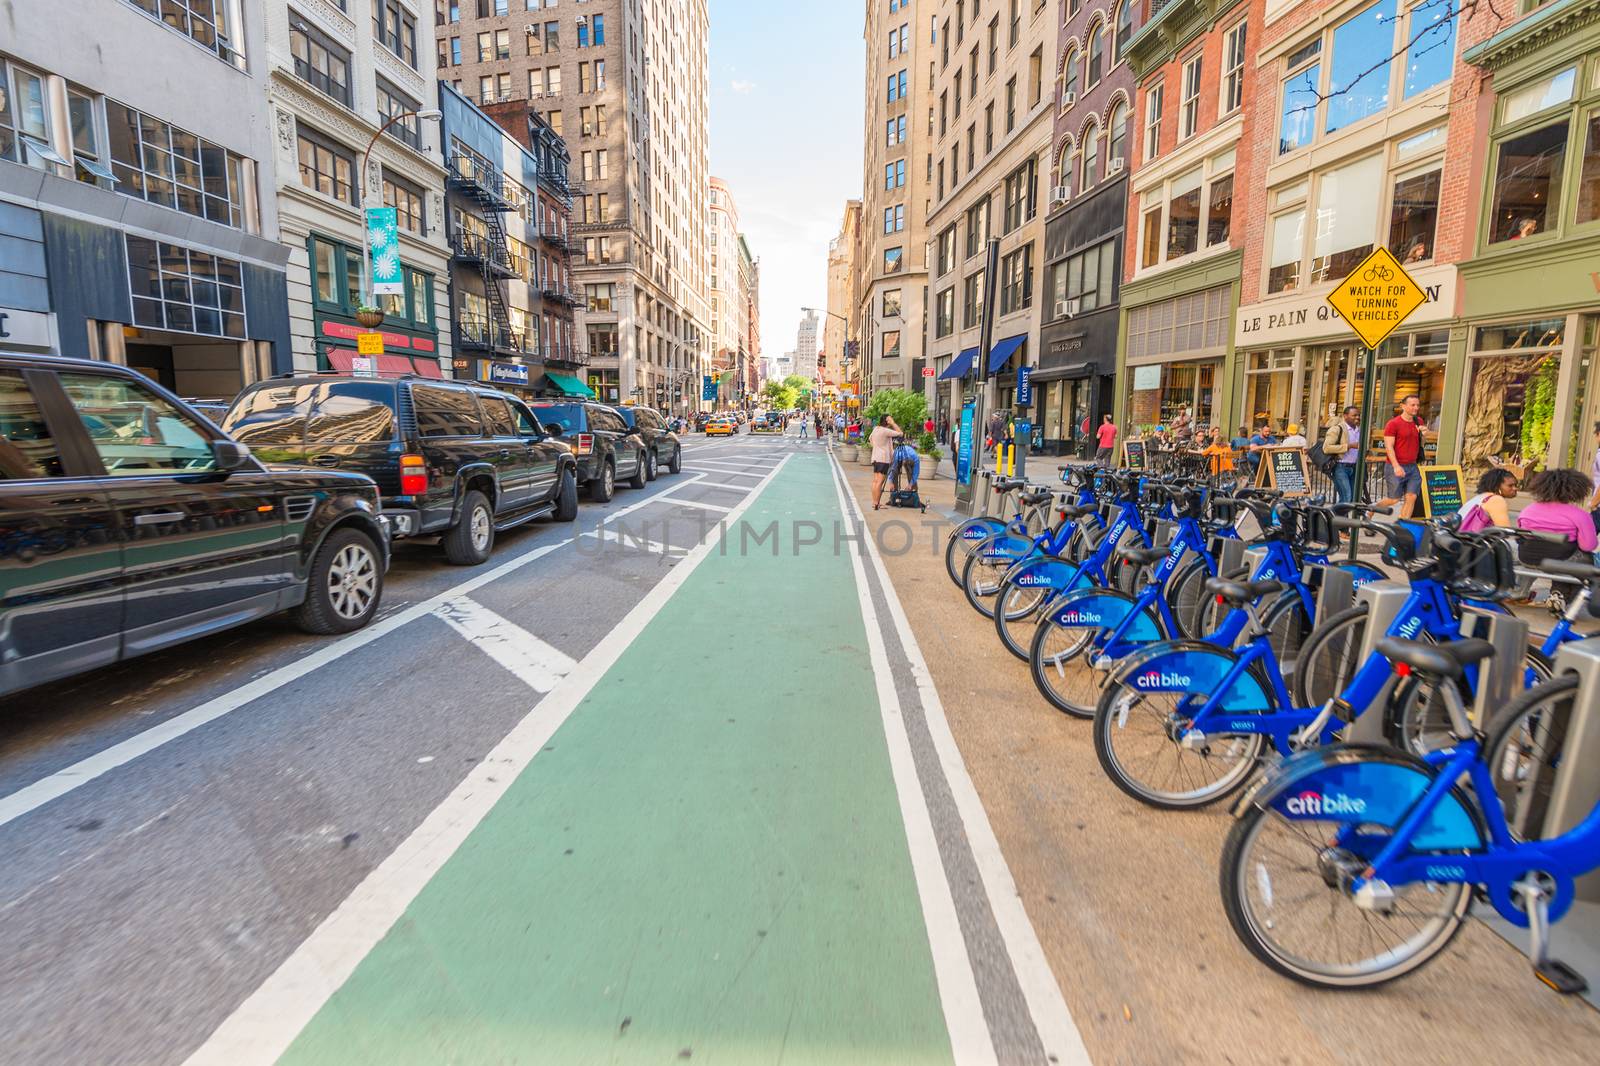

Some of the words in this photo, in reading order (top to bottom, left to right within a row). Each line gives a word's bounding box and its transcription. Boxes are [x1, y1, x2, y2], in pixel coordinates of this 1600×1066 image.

[1350, 286, 1381, 296] WATCH
[1387, 286, 1406, 295] FOR
[1356, 298, 1398, 309] TURNING
[1243, 317, 1261, 333] LE
[1268, 309, 1308, 329] PAIN
[1351, 310, 1400, 321] VEHICLES
[1021, 370, 1029, 402] FLORIST
